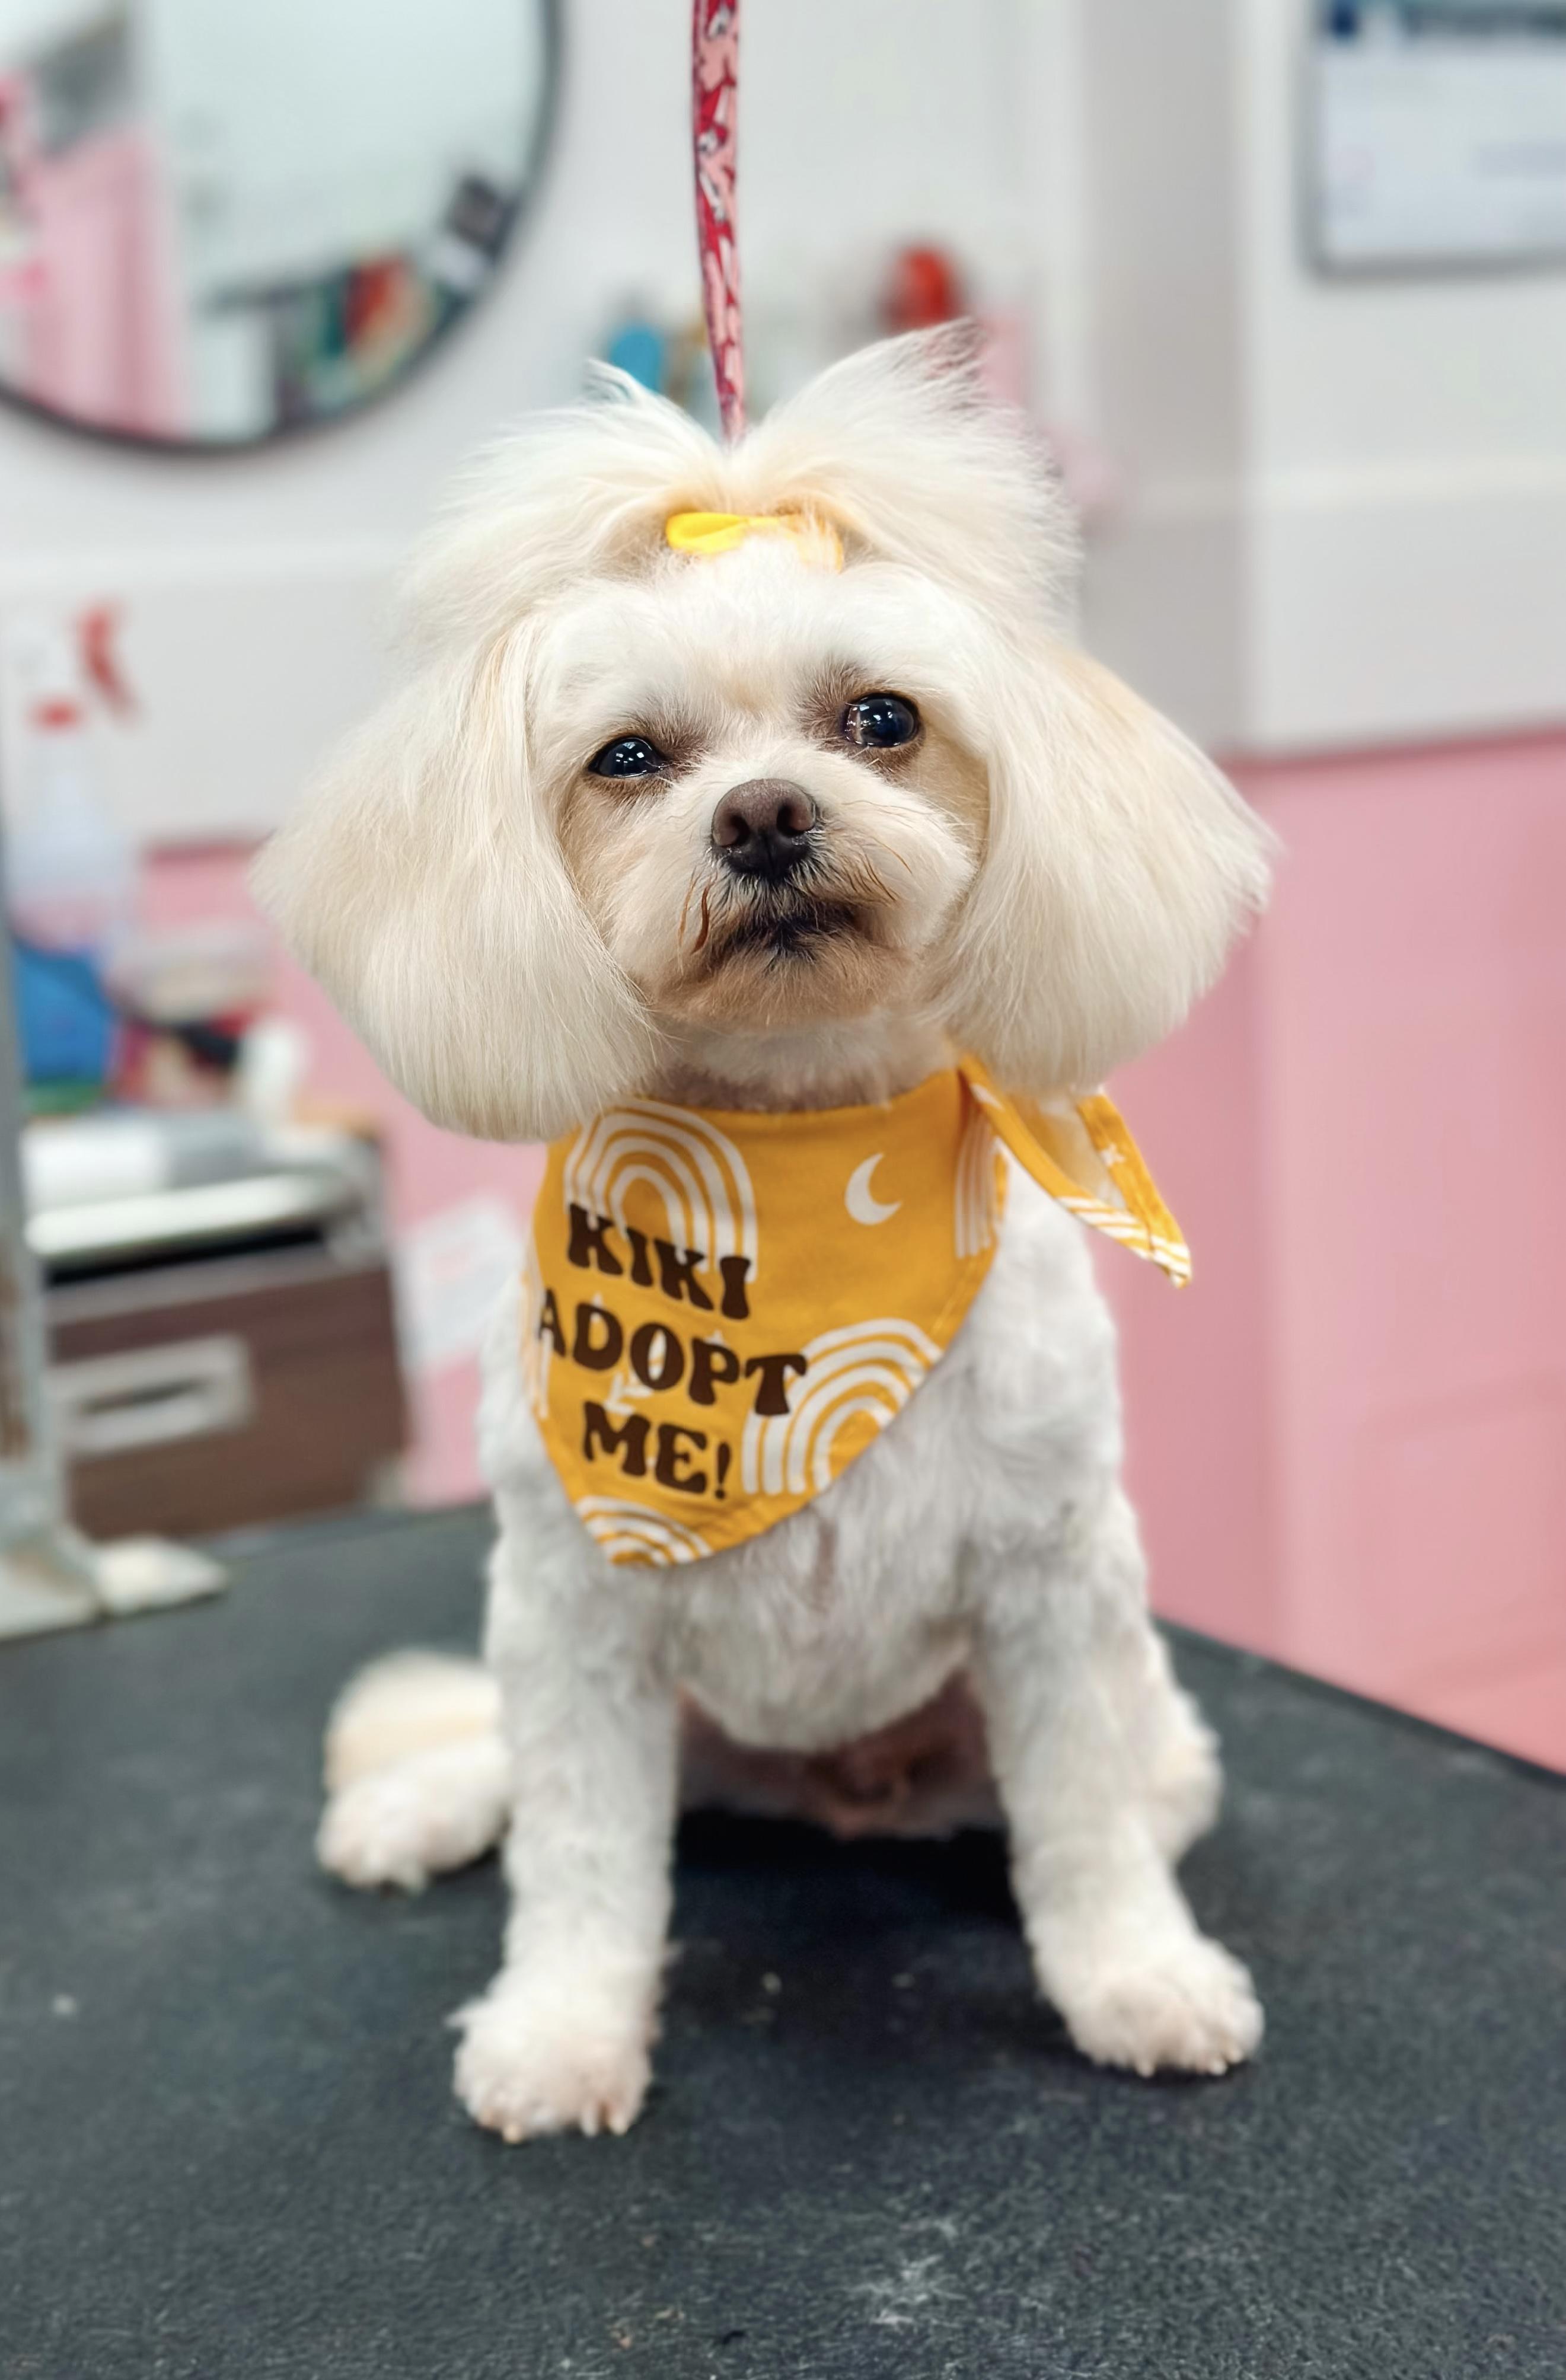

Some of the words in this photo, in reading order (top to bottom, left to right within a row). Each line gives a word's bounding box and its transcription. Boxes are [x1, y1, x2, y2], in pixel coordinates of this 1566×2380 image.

[567, 1202, 751, 1320] KIKI
[538, 1288, 808, 1416] ADOPT
[583, 1400, 732, 1500] ME!
